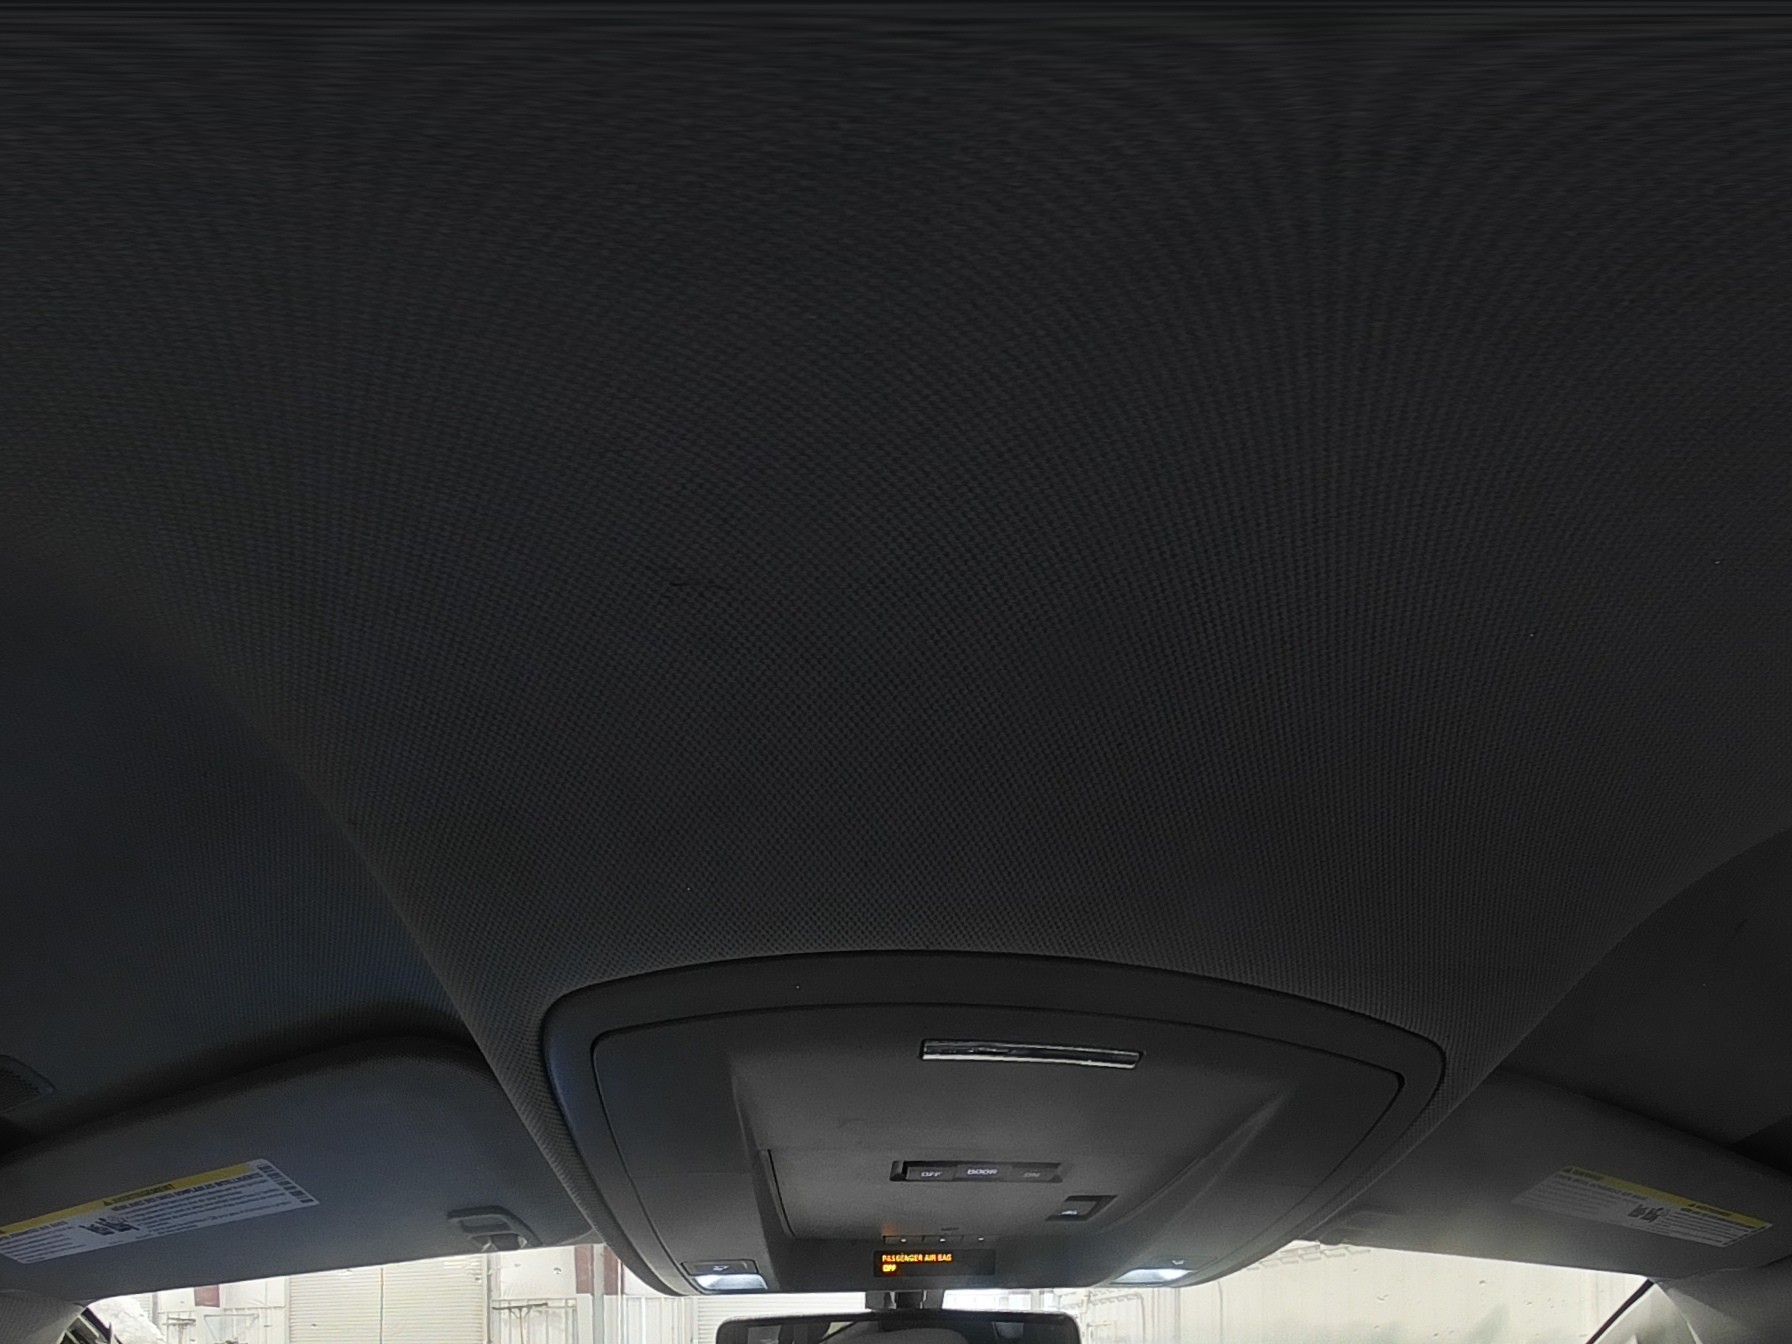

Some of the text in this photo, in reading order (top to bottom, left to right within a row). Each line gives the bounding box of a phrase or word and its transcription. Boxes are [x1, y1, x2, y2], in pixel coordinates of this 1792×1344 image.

[966, 1168, 998, 1176] DOOR
[881, 1253, 952, 1263] PASSENGER AIR BAG
